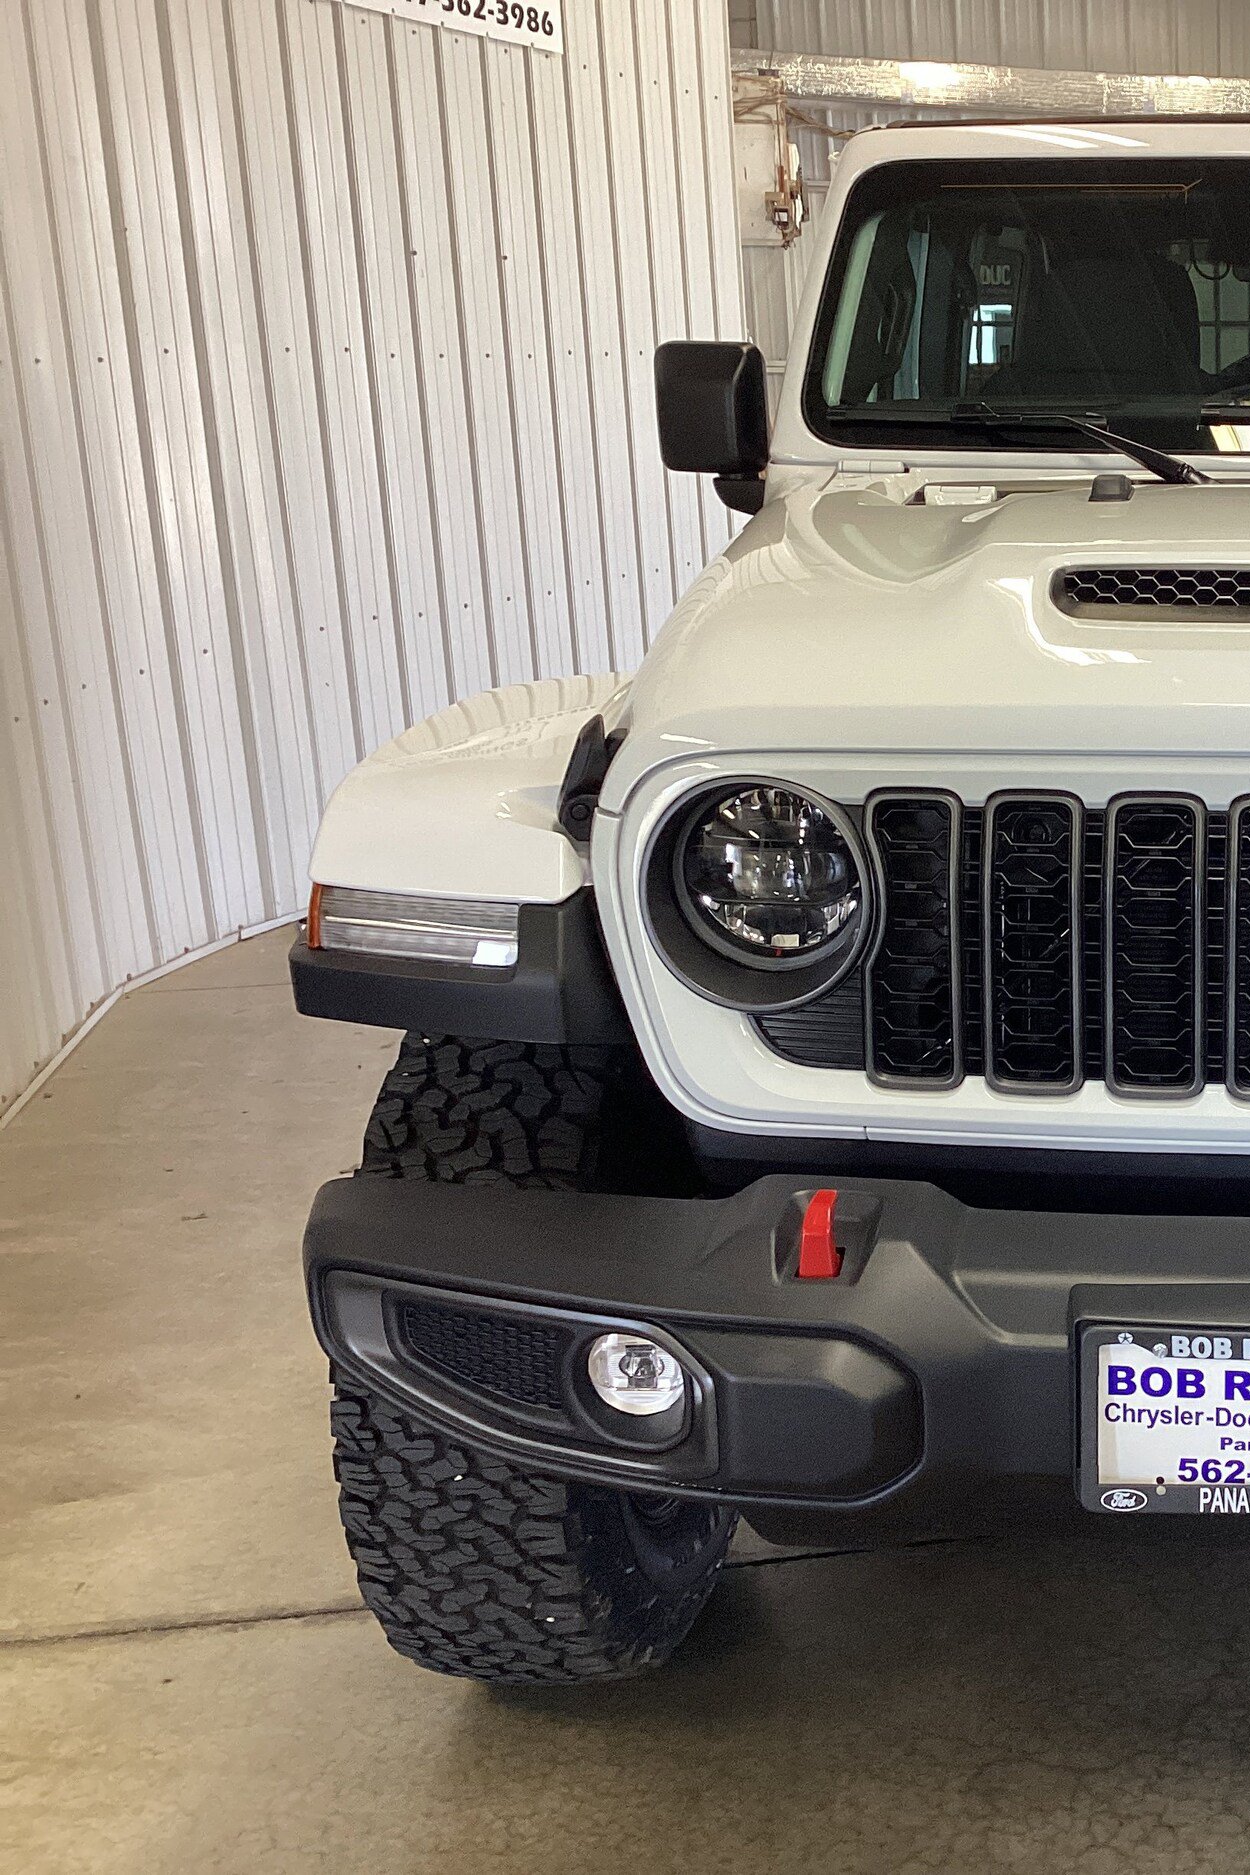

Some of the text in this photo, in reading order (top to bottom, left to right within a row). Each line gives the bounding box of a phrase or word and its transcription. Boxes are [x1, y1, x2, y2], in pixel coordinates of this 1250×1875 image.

[405, 0, 554, 36] 62-3986
[1171, 1335, 1233, 1359] BOB
[1107, 1365, 1206, 1399] BOB
